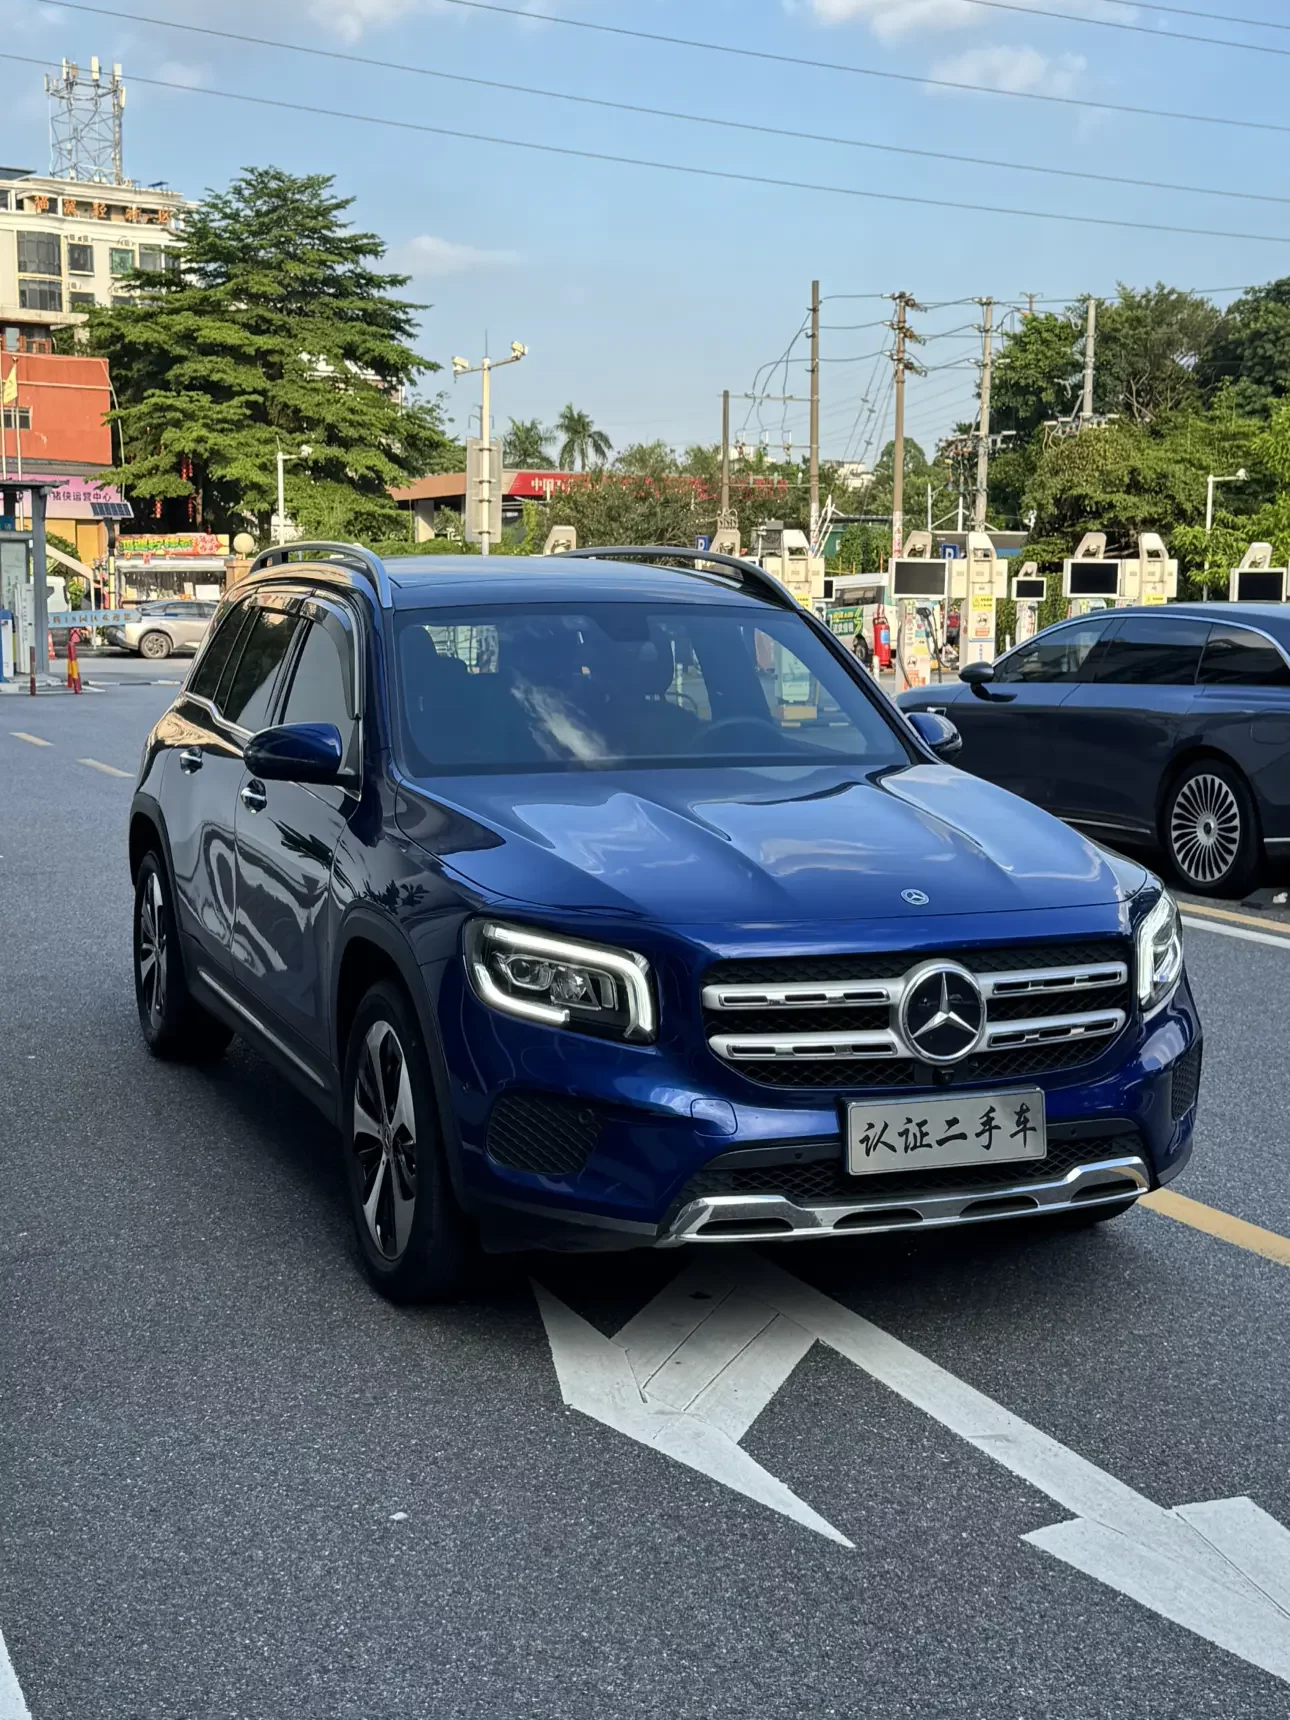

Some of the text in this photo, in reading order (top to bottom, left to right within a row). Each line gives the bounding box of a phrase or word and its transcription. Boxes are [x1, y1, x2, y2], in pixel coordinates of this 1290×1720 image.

[50, 491, 112, 502] 猪侠运营中心
[859, 1102, 1037, 1157] 认证二手车
